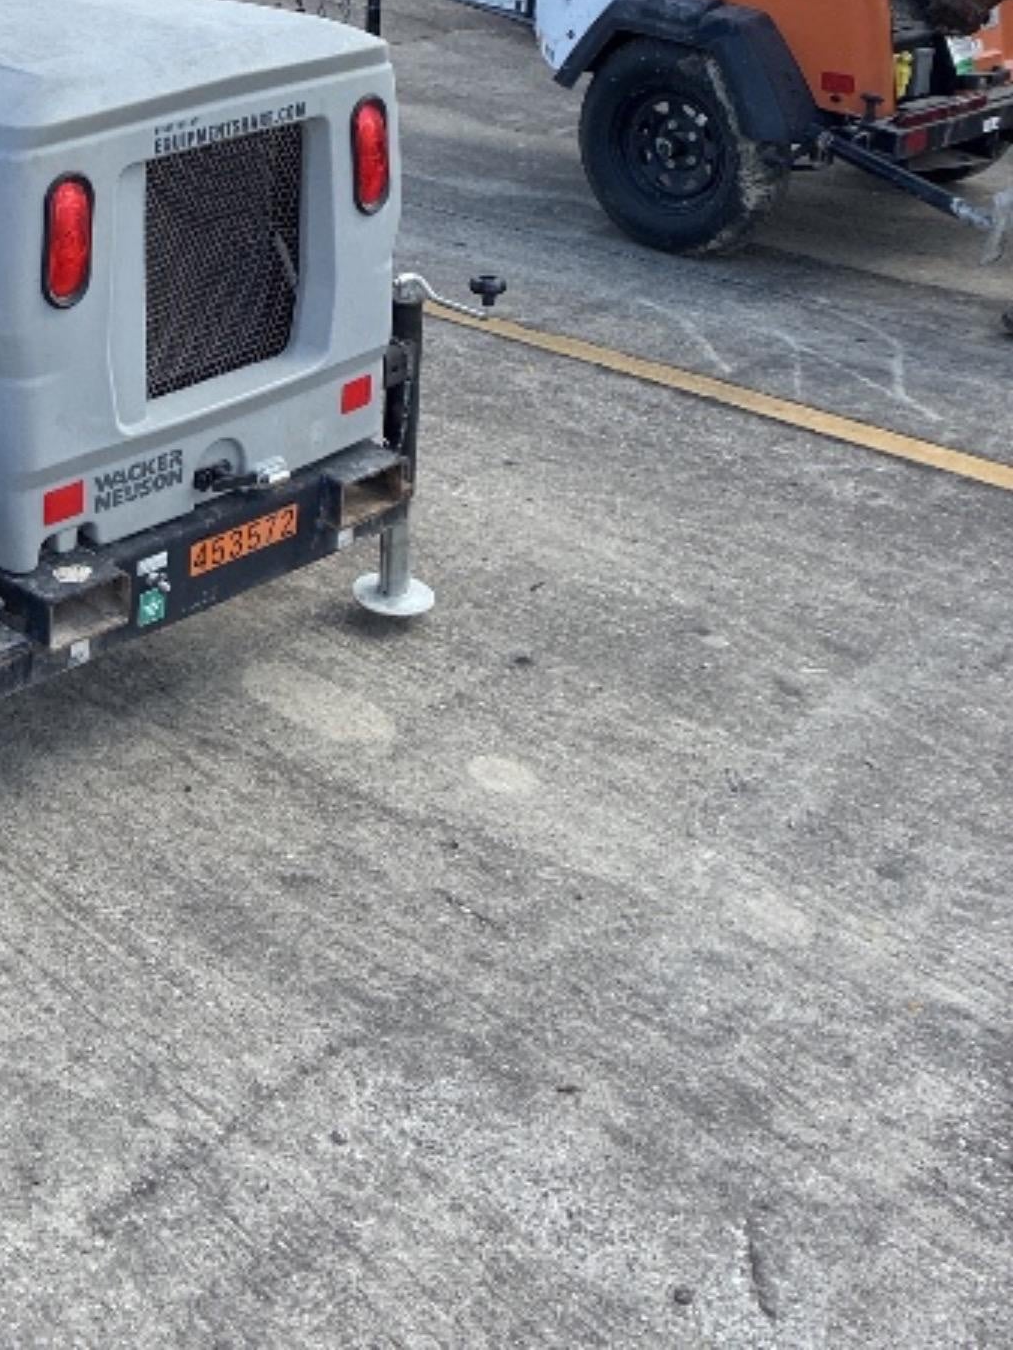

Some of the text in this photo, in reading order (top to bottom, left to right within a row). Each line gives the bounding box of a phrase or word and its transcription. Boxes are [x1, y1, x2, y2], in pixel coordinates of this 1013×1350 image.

[95, 449, 183, 492] WACKER
[95, 469, 183, 514] NEUSON
[193, 508, 294, 569] 453572
